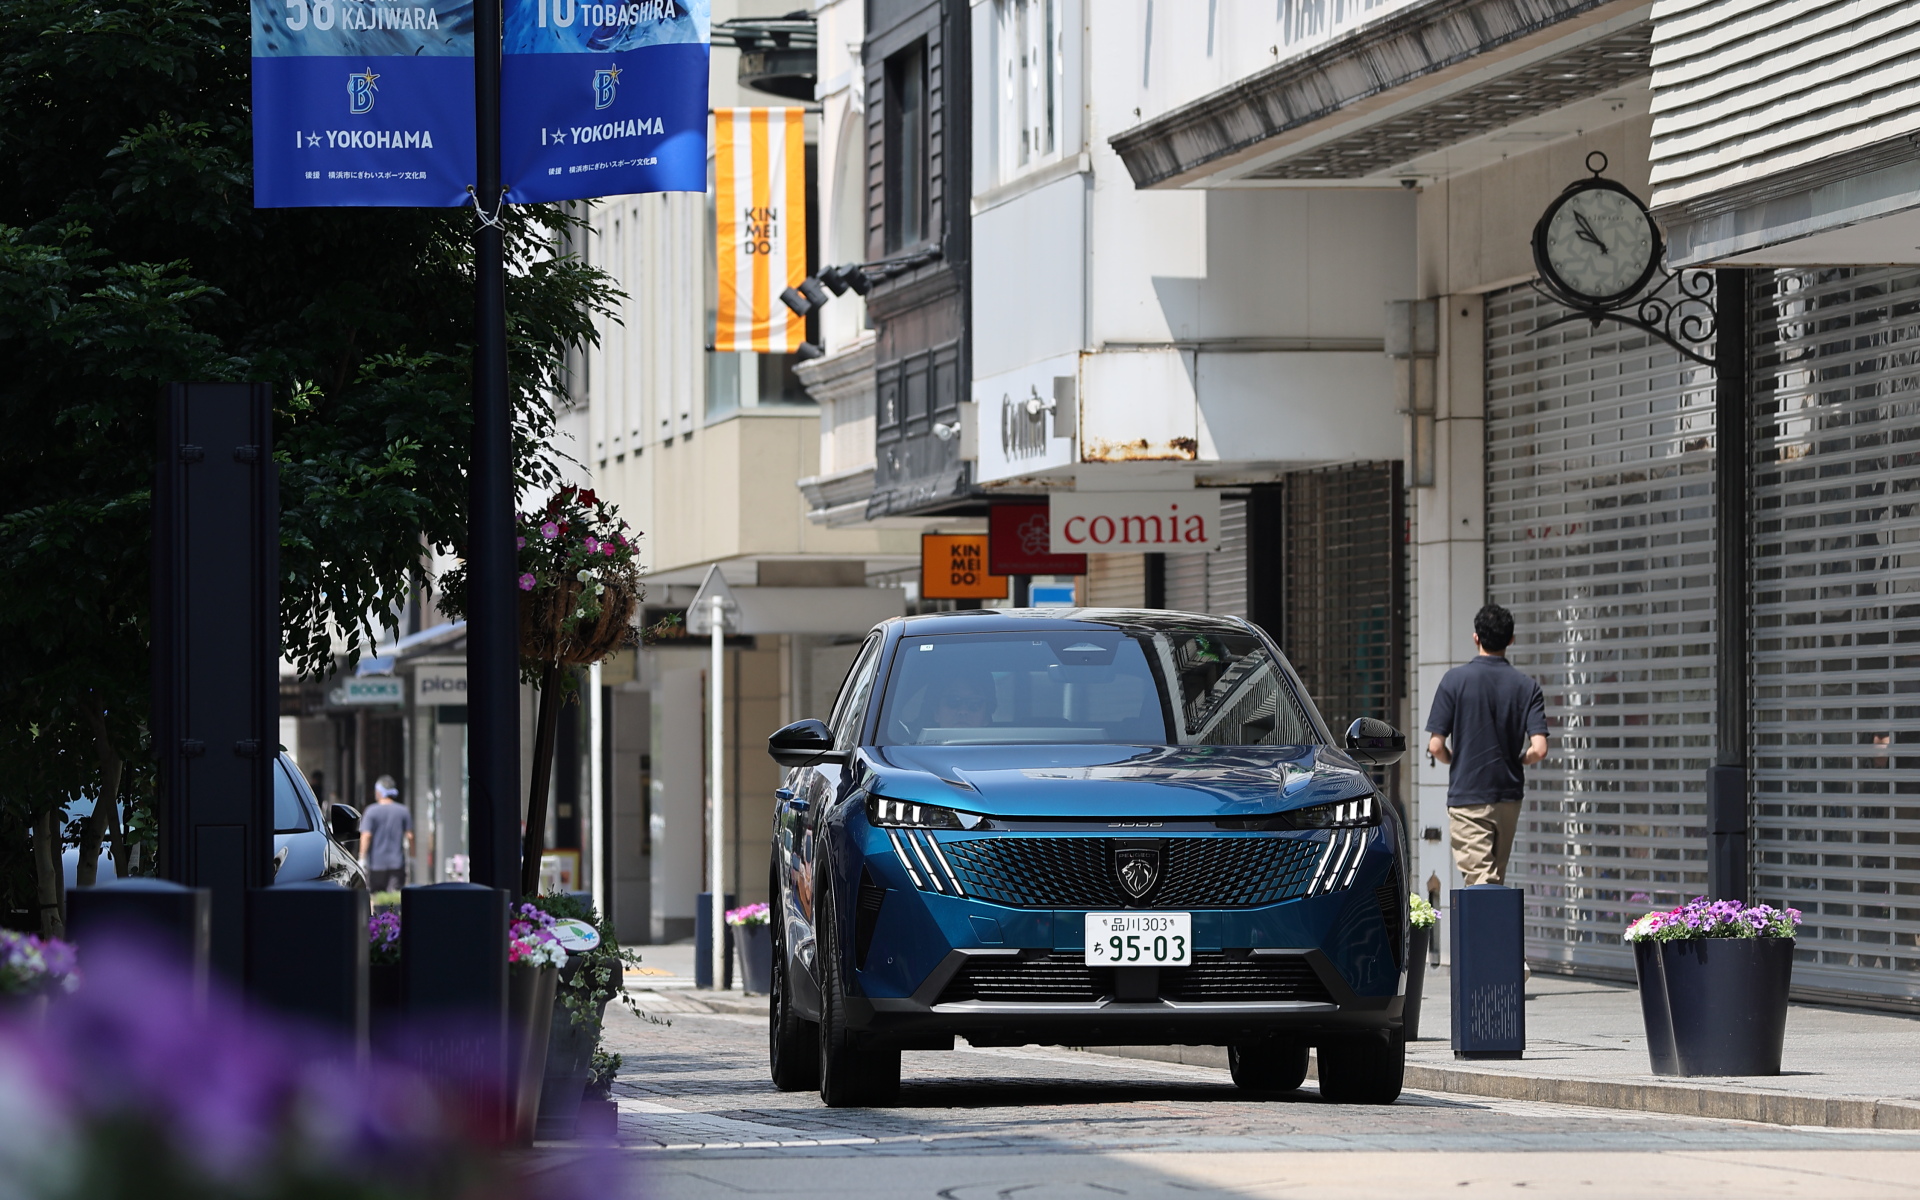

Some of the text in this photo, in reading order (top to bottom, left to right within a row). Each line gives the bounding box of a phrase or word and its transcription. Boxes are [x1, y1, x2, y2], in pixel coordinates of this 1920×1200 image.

[342, 7, 439, 30] KAJIWARA
[581, 0, 676, 27] TOBASHIRA
[570, 116, 665, 145] YOKOHAMA
[325, 130, 433, 149] YOKOHAMA
[568, 156, 658, 174] 横浜市にぎわいスポーツ文化局
[304, 170, 427, 180] 後援 横浜市にぎわいスポーツ文化局
[744, 206, 777, 222] KIN
[744, 224, 777, 238] MEI
[744, 240, 771, 255] DO
[1063, 504, 1209, 544] comia
[950, 544, 981, 557] KIN
[950, 559, 981, 571] MEI
[950, 572, 977, 586] DO
[350, 683, 399, 696] BOOKS
[1109, 935, 1186, 962] 95-03
